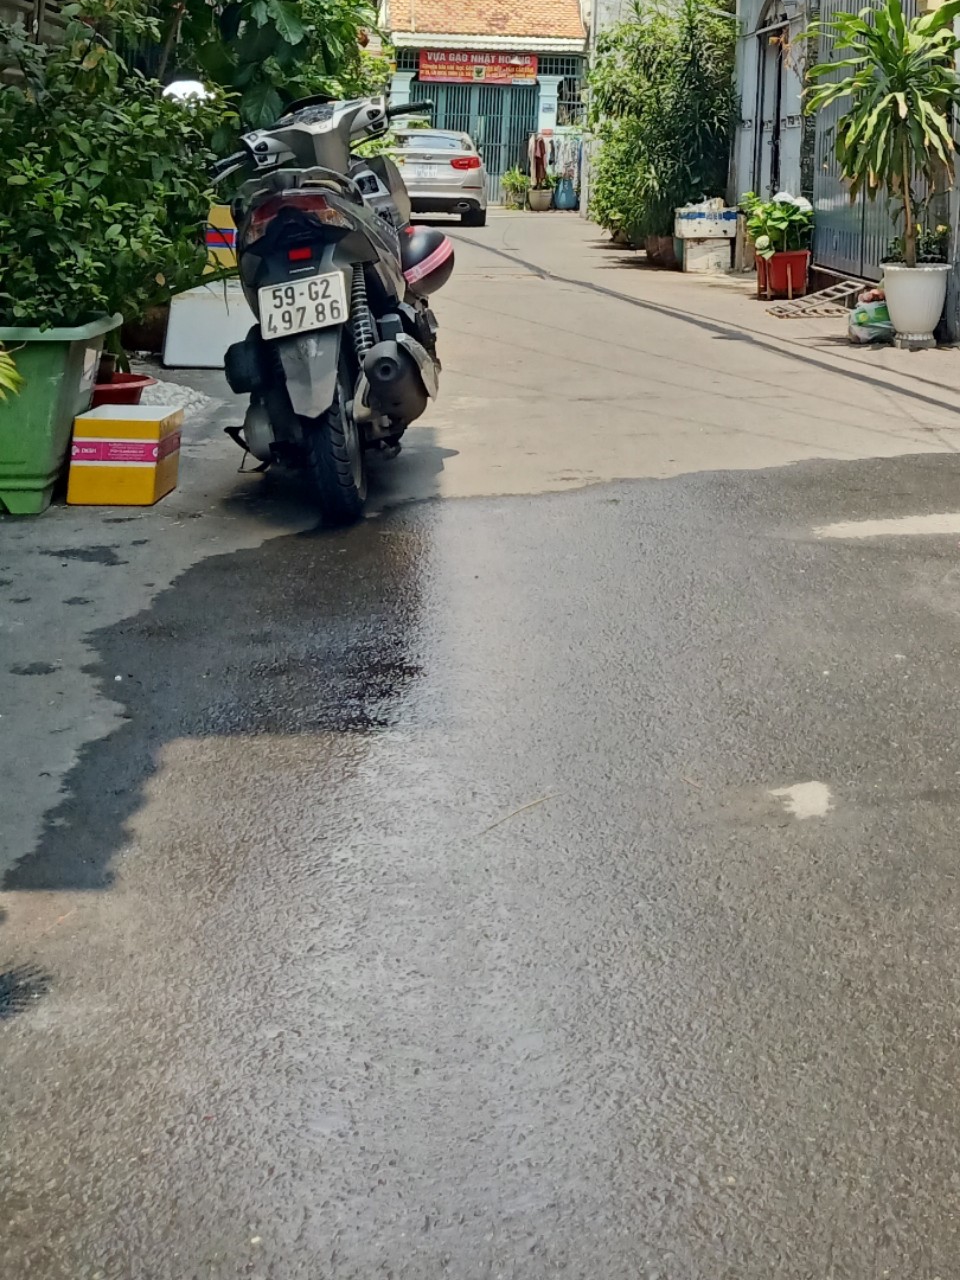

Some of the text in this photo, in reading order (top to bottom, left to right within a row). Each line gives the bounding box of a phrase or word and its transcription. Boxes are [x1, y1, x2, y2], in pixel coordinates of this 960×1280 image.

[470, 54, 496, 65] NHẬT
[272, 278, 332, 309] 59-G2
[267, 299, 341, 334] 497.86
